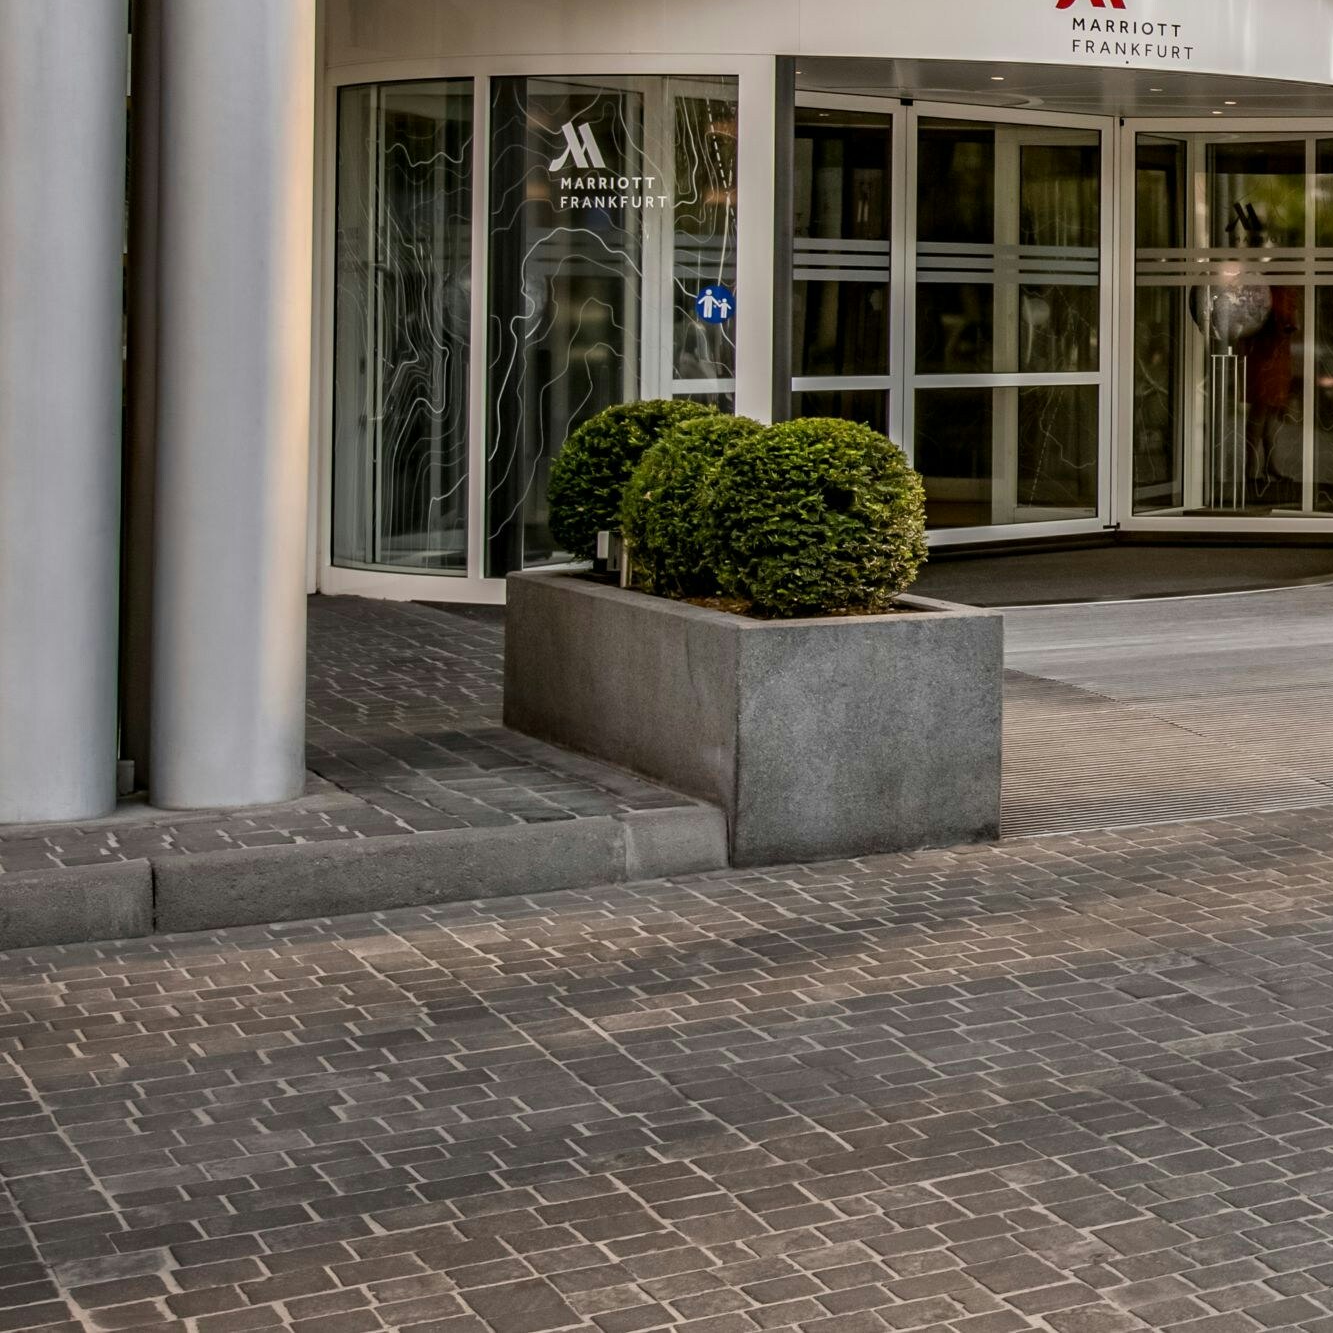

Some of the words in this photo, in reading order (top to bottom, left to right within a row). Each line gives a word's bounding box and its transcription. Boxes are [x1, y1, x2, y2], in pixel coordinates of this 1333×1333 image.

[1072, 17, 1181, 37] MARRIOTT
[1072, 39, 1194, 60] FRANKFURT
[560, 177, 656, 190] MARRIOTT
[560, 196, 668, 209] FRANKFURT
